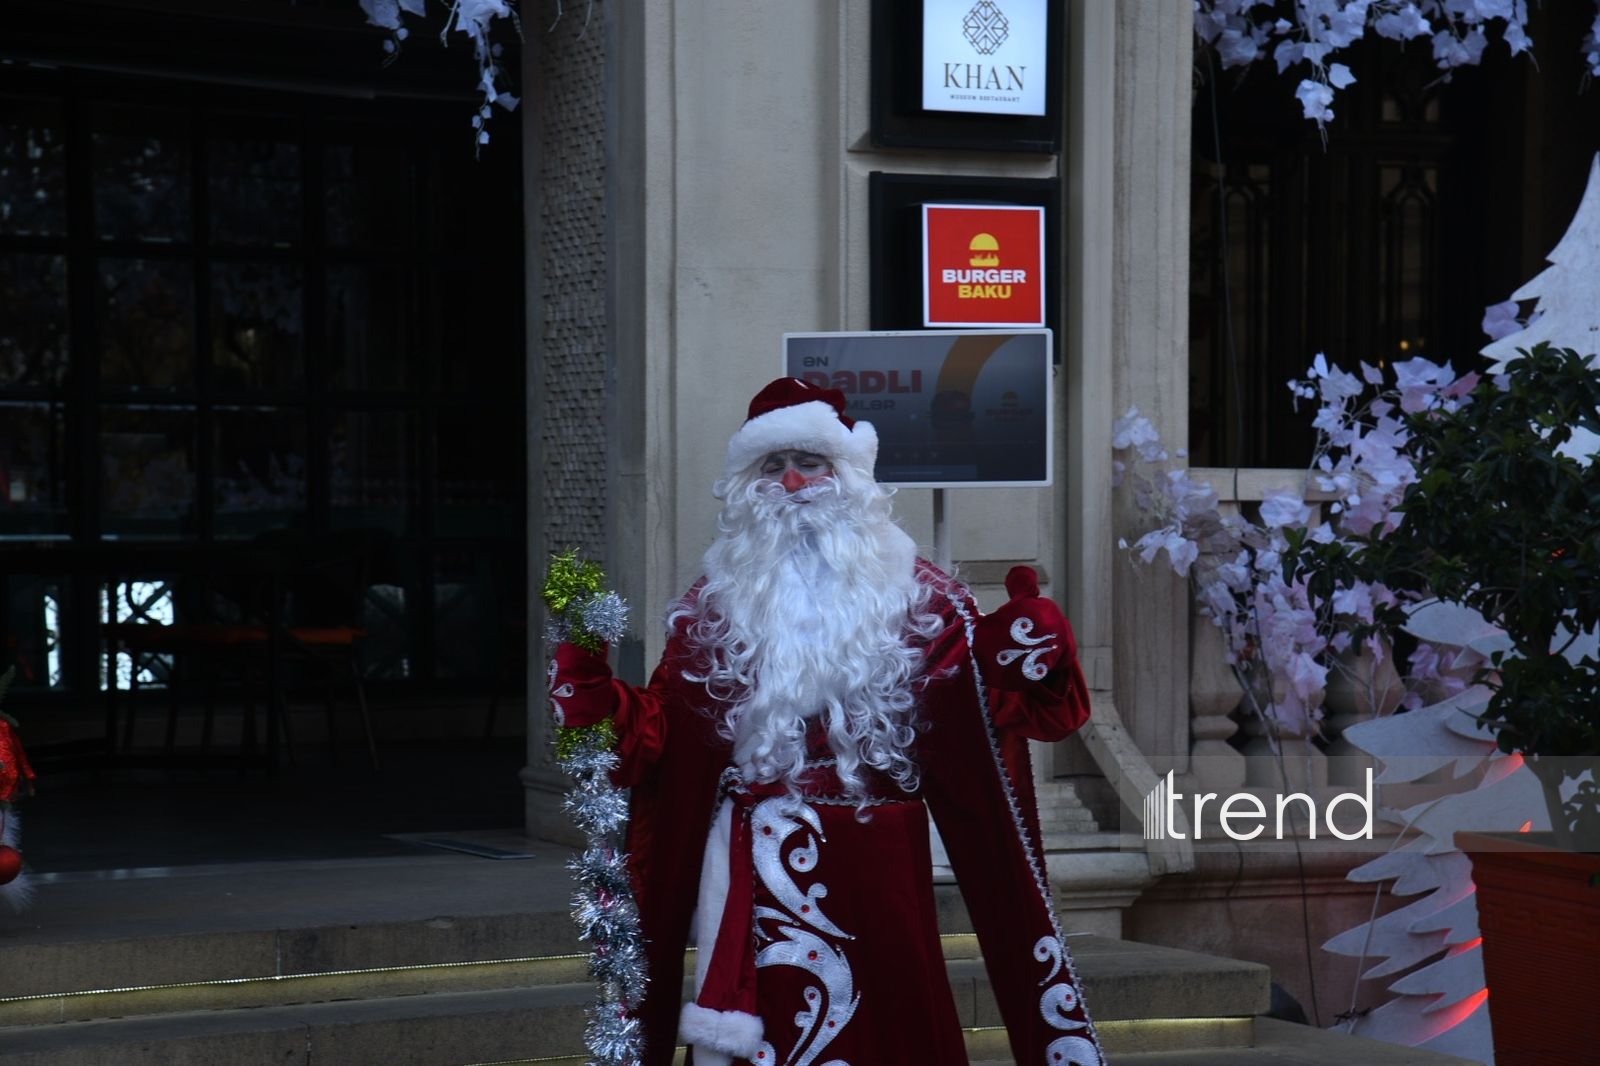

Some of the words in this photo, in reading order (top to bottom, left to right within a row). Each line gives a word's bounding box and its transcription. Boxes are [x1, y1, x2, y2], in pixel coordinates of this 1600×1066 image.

[943, 62, 1027, 91] KHAN
[942, 269, 1026, 283] BURGER
[958, 285, 1011, 298] BAKU
